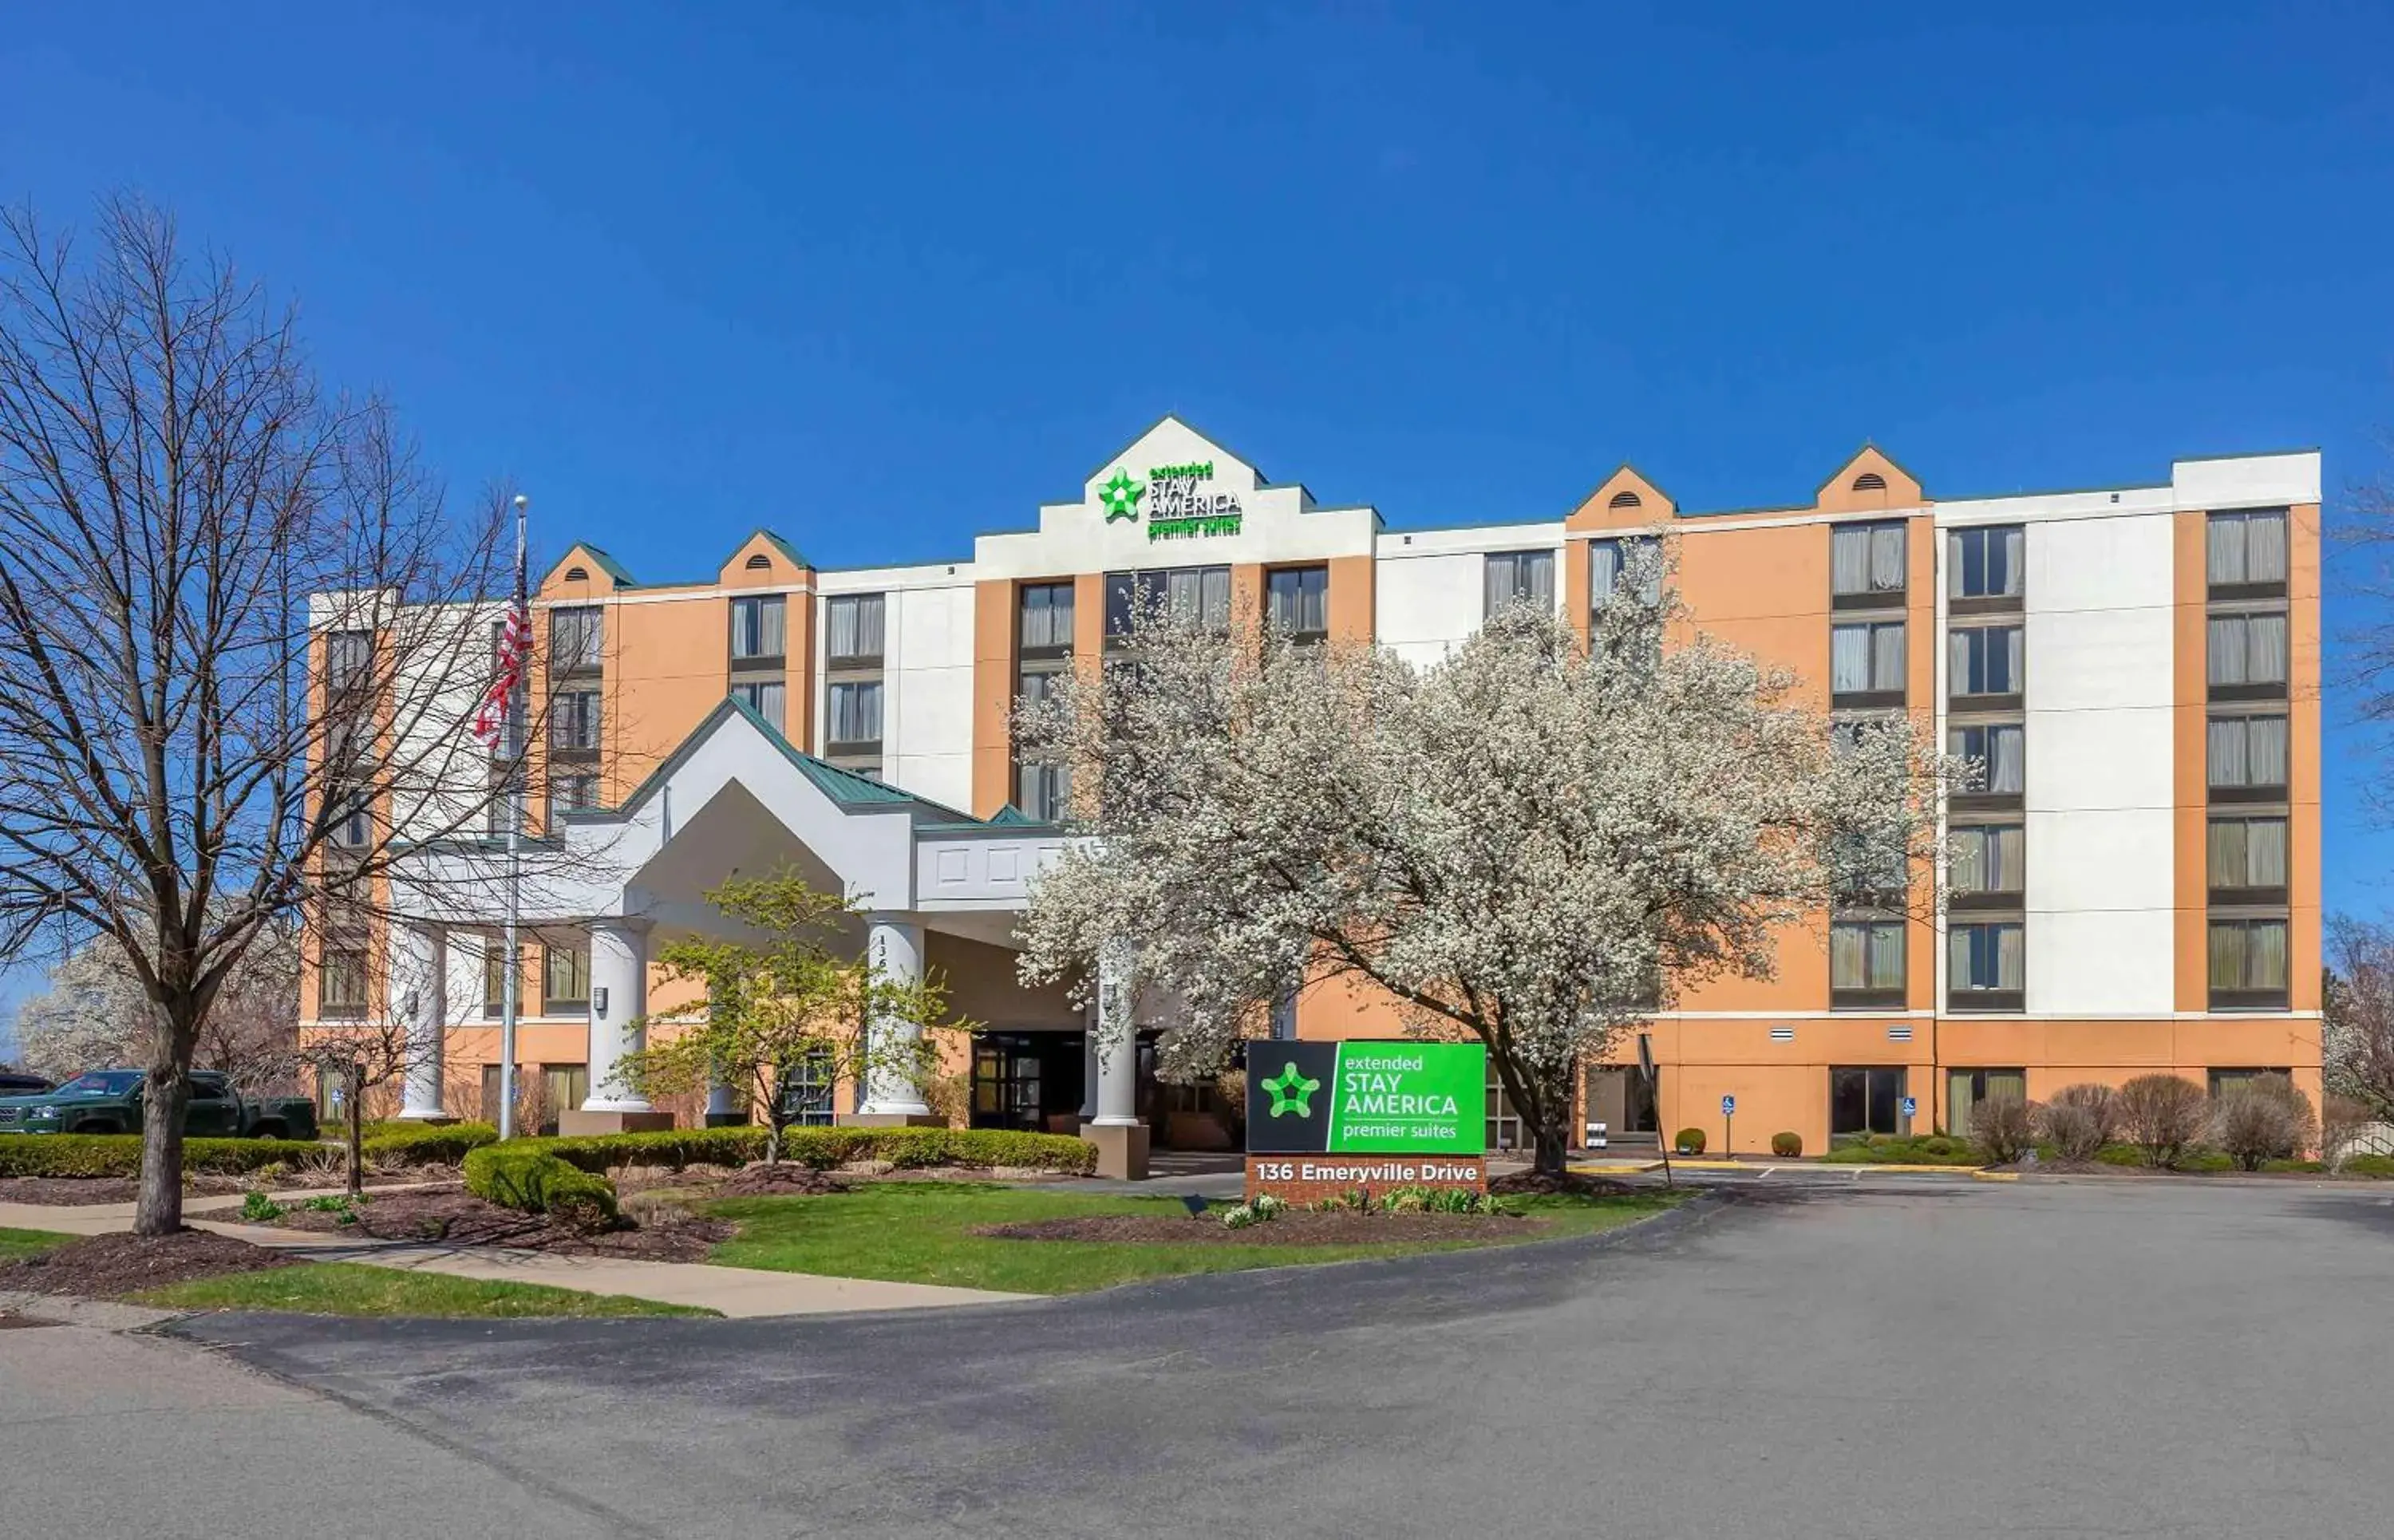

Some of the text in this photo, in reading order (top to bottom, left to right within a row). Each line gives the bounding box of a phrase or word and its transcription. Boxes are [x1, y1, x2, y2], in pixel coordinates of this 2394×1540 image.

[1149, 460, 1214, 478] extended
[1150, 476, 1195, 497] STAY
[1149, 492, 1240, 518] AMERICA
[1148, 517, 1240, 542] premier suites
[1345, 1055, 1423, 1071] extended
[1345, 1073, 1402, 1092] STAY
[1344, 1094, 1459, 1115] AMERICA
[1343, 1123, 1456, 1141] premier suites
[1257, 1163, 1477, 1183] 136 Emeryville Drive
